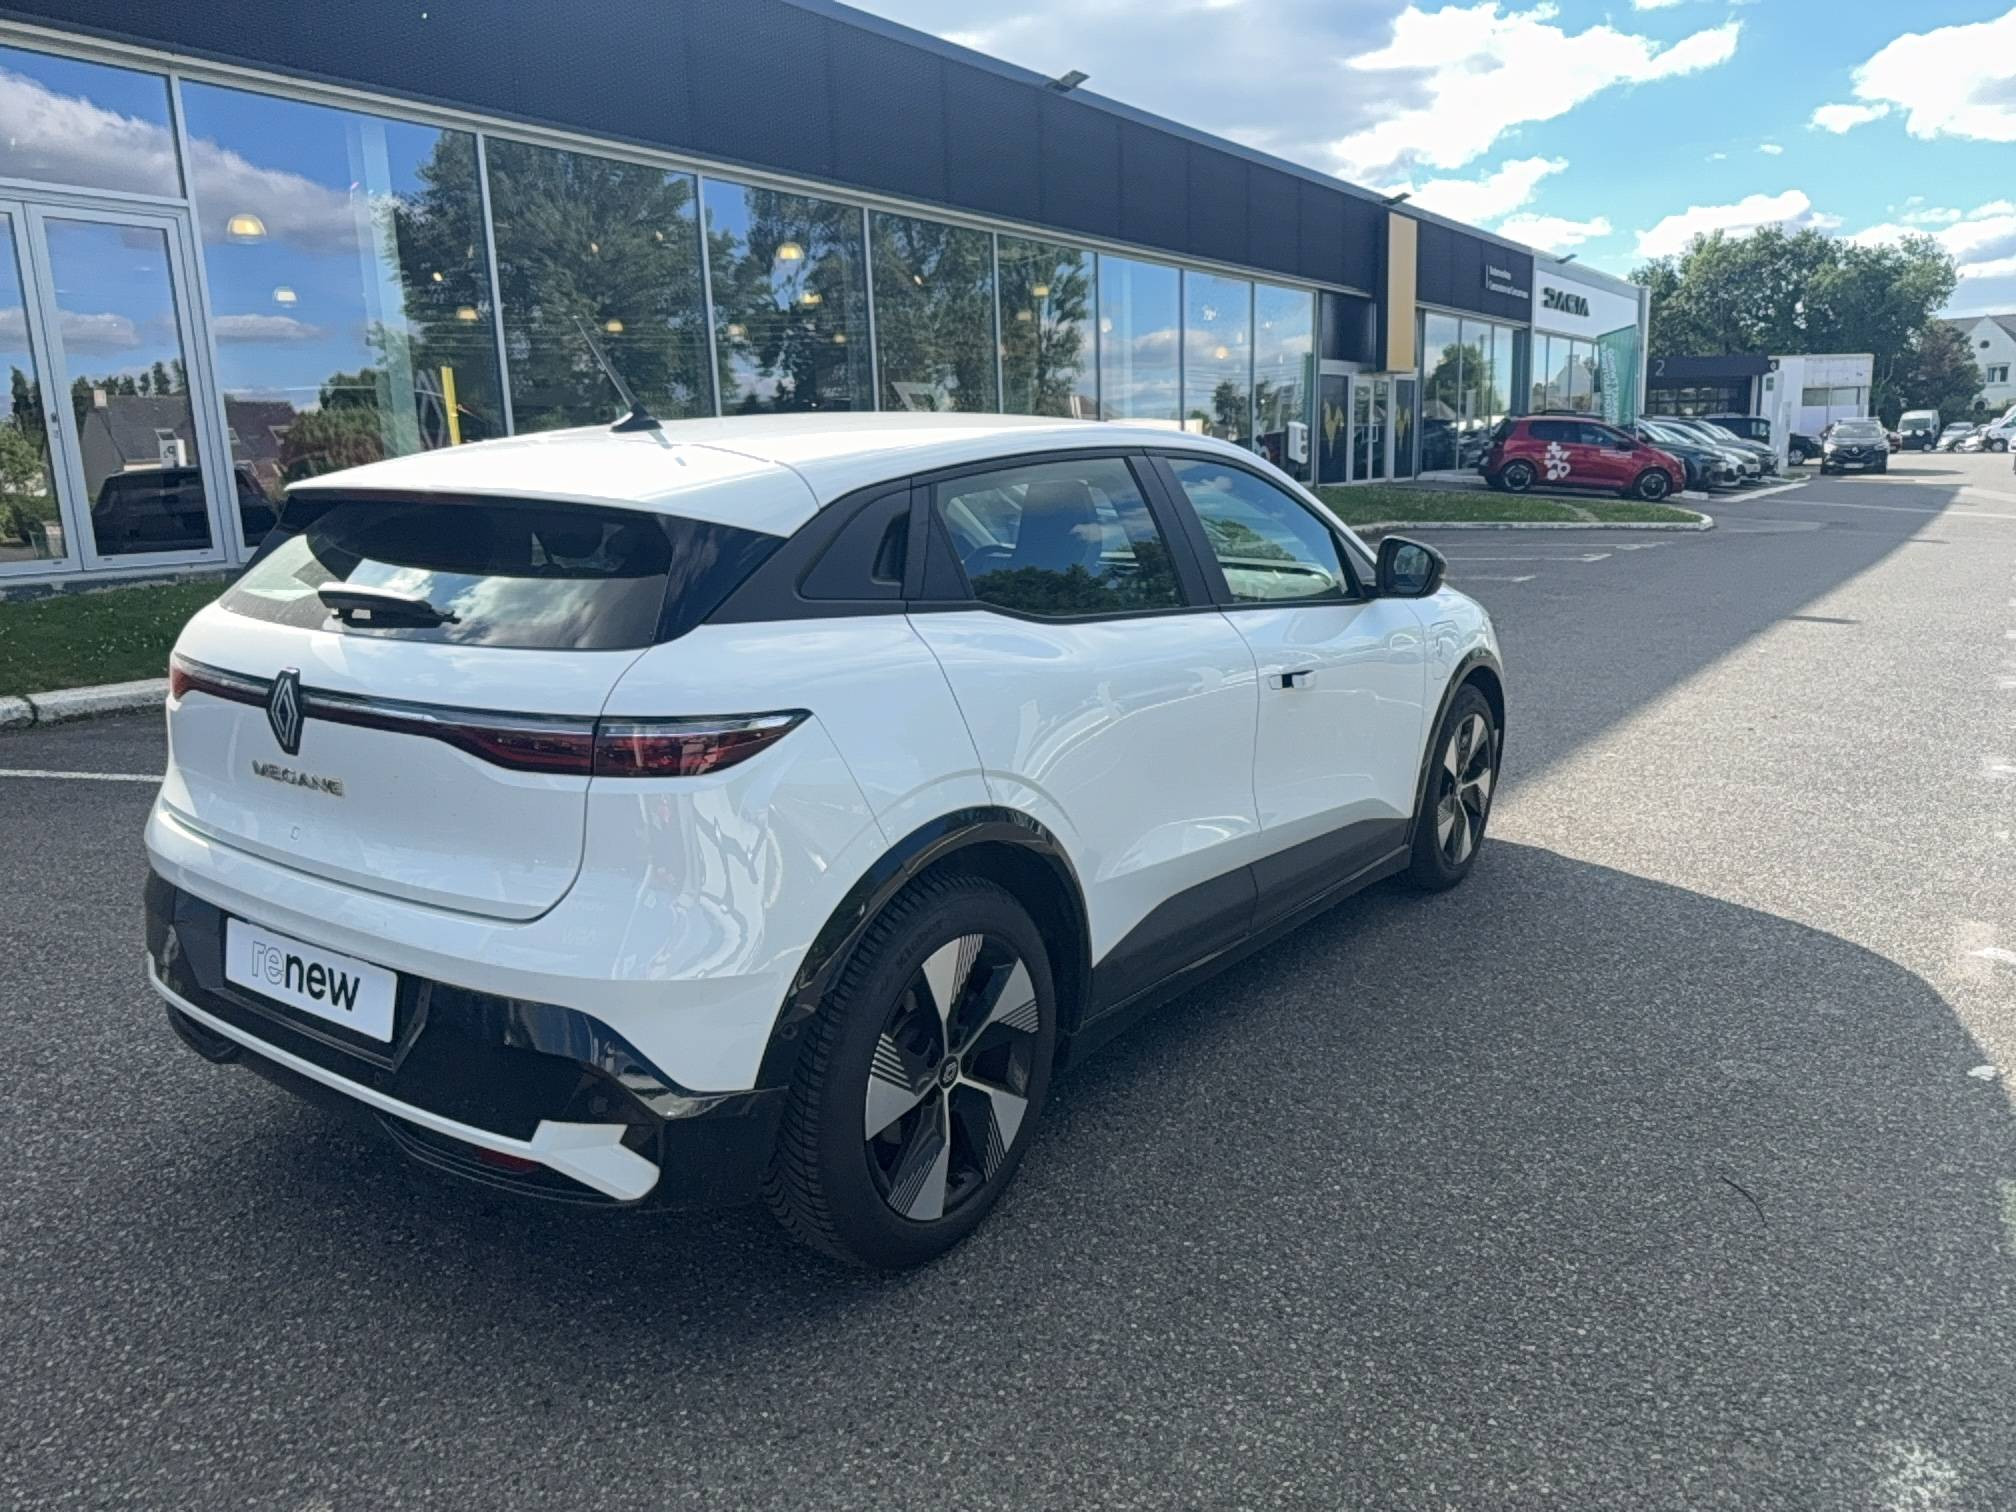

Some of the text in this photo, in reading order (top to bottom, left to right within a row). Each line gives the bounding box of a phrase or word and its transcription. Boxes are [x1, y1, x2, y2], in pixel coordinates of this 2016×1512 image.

[1655, 359, 1665, 377] 2
[252, 760, 344, 797] MEGANE
[251, 940, 361, 1012] renew
